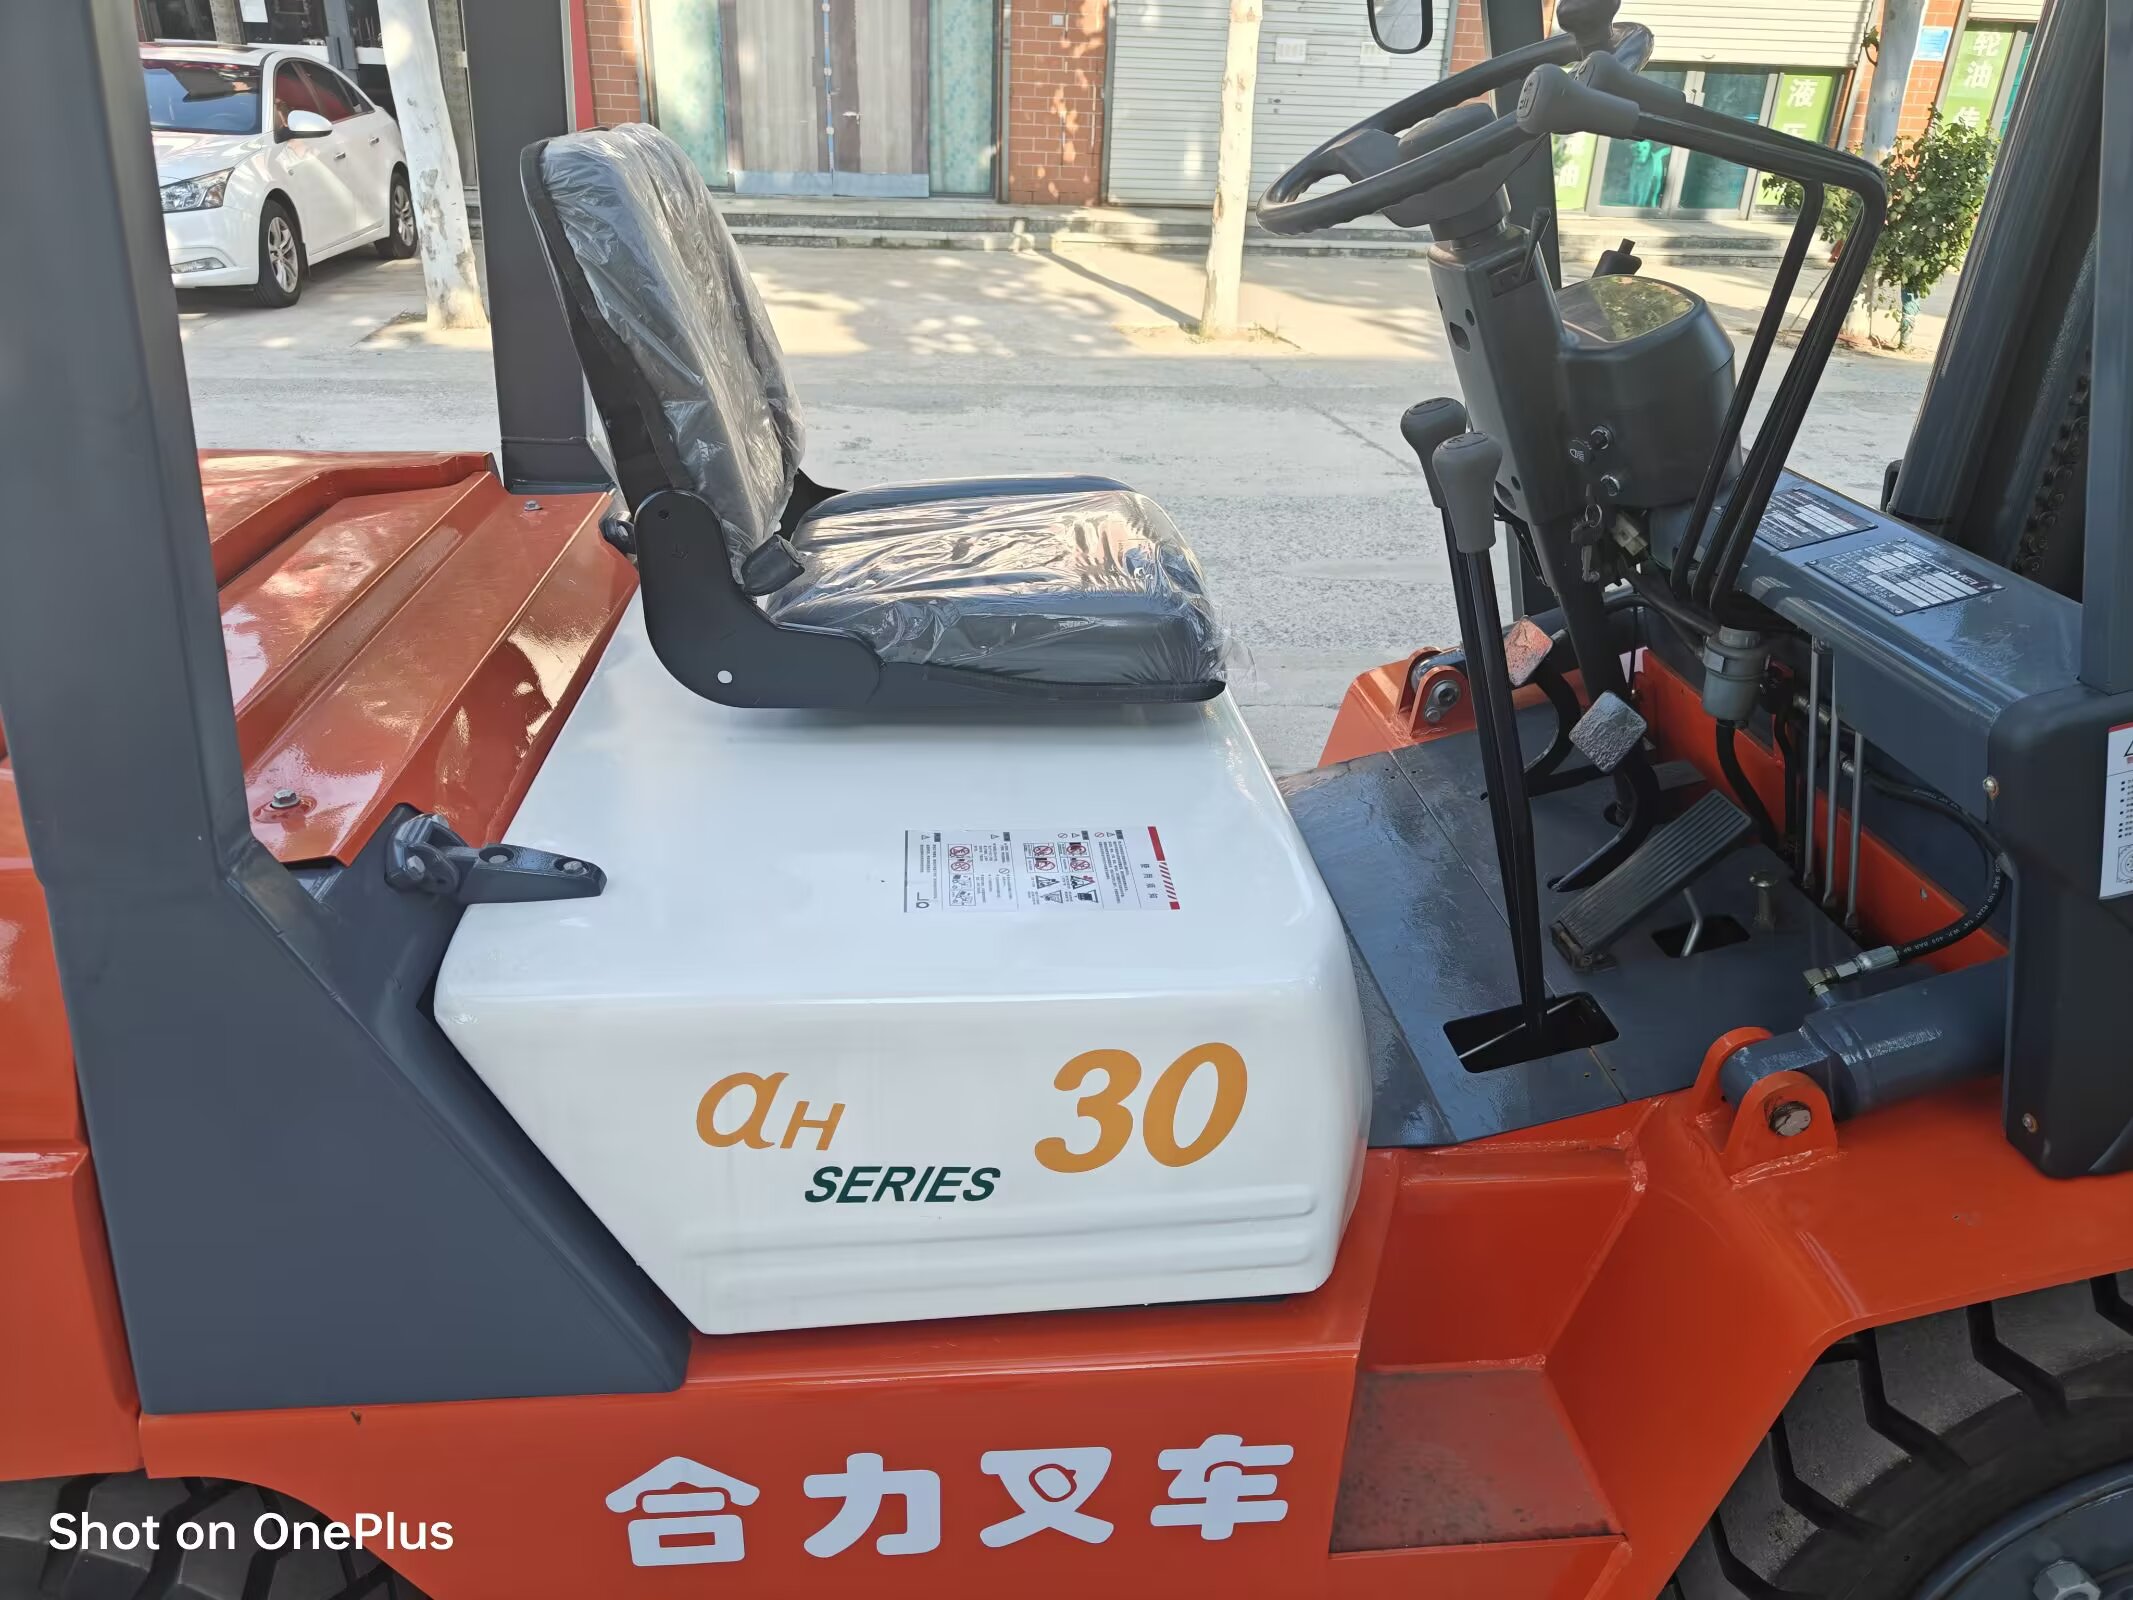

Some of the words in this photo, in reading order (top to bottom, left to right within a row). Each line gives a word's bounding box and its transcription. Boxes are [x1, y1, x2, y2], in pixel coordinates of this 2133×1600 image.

[1034, 1042, 1248, 1174] 30
[804, 1166, 1001, 1204] SERIES
[605, 1433, 1295, 1567] 合力叉车
